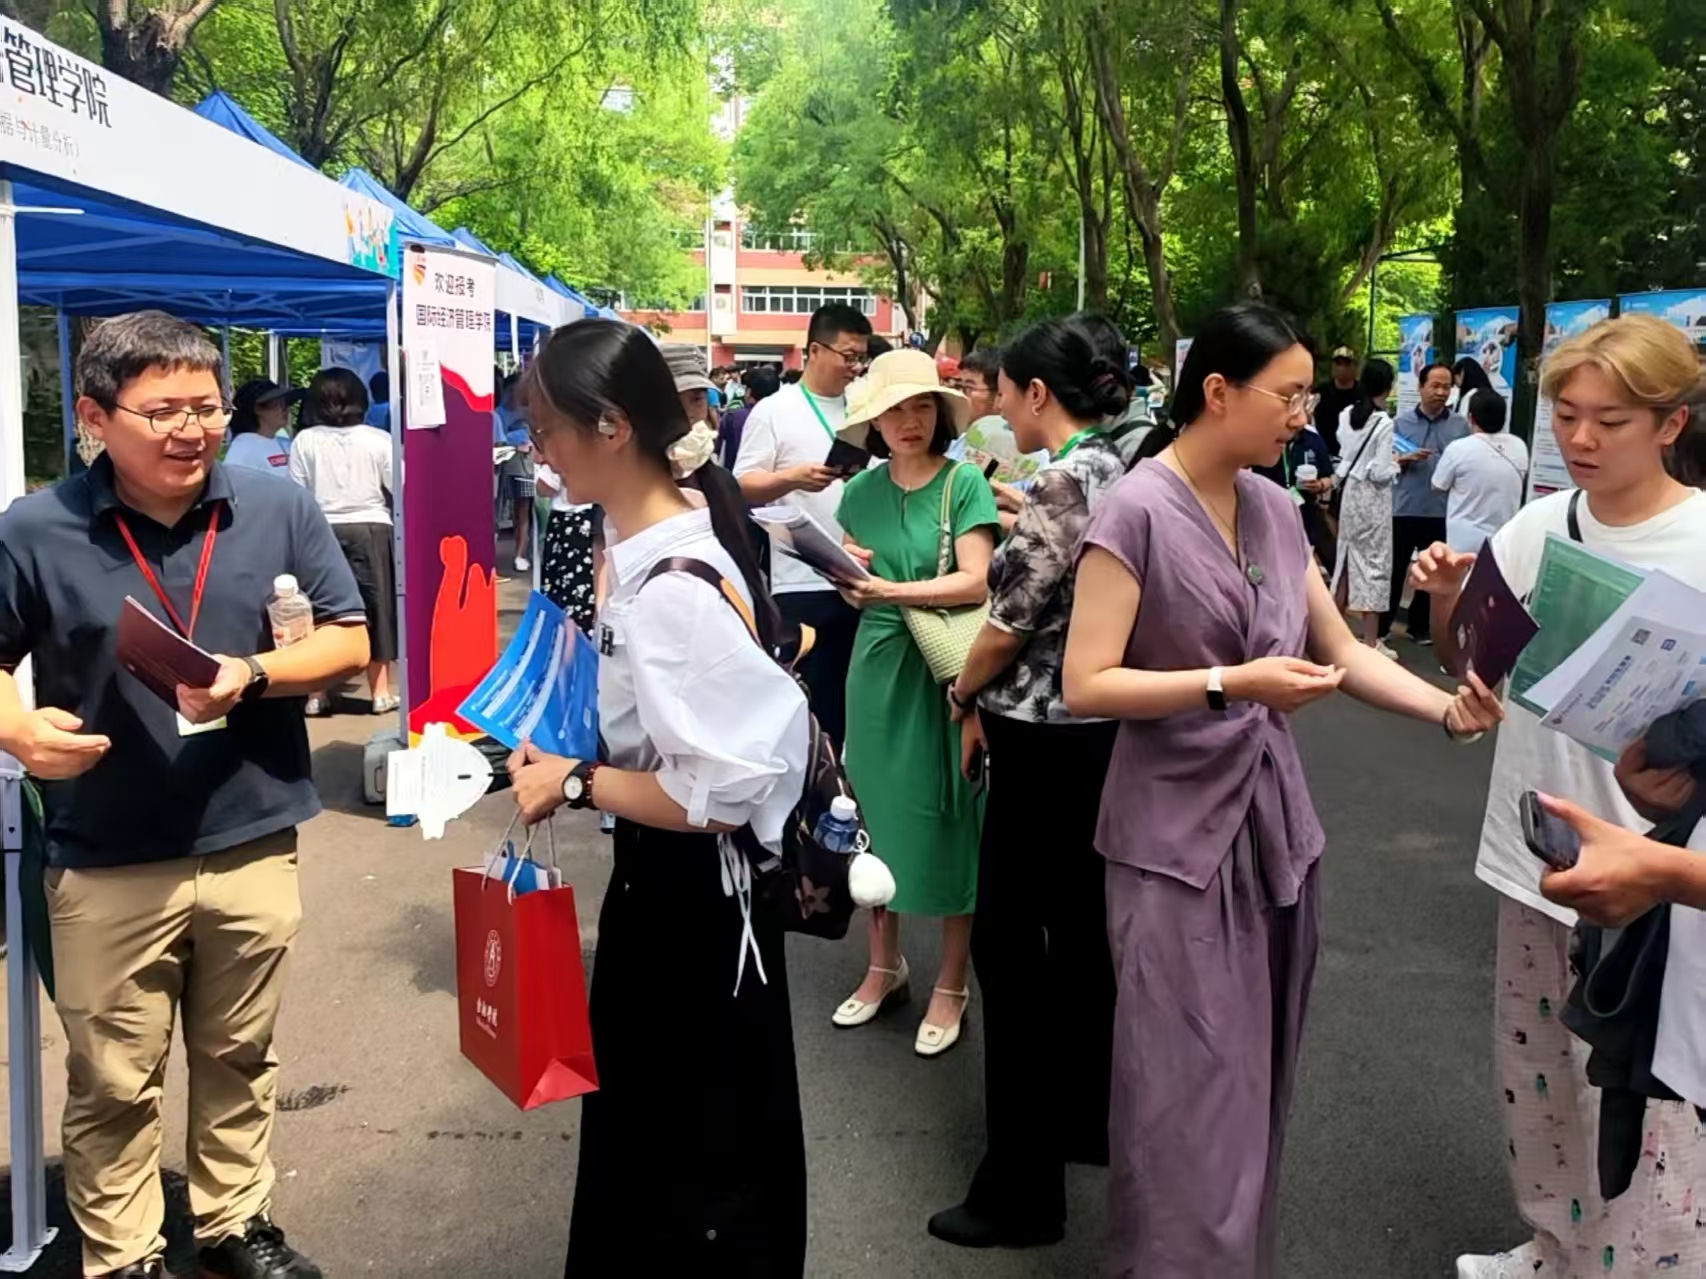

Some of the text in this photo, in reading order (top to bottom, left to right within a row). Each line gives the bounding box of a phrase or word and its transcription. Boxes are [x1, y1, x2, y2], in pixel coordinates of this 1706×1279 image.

[0, 26, 112, 128] 管理学院
[416, 303, 491, 332] 国际经济管理学院
